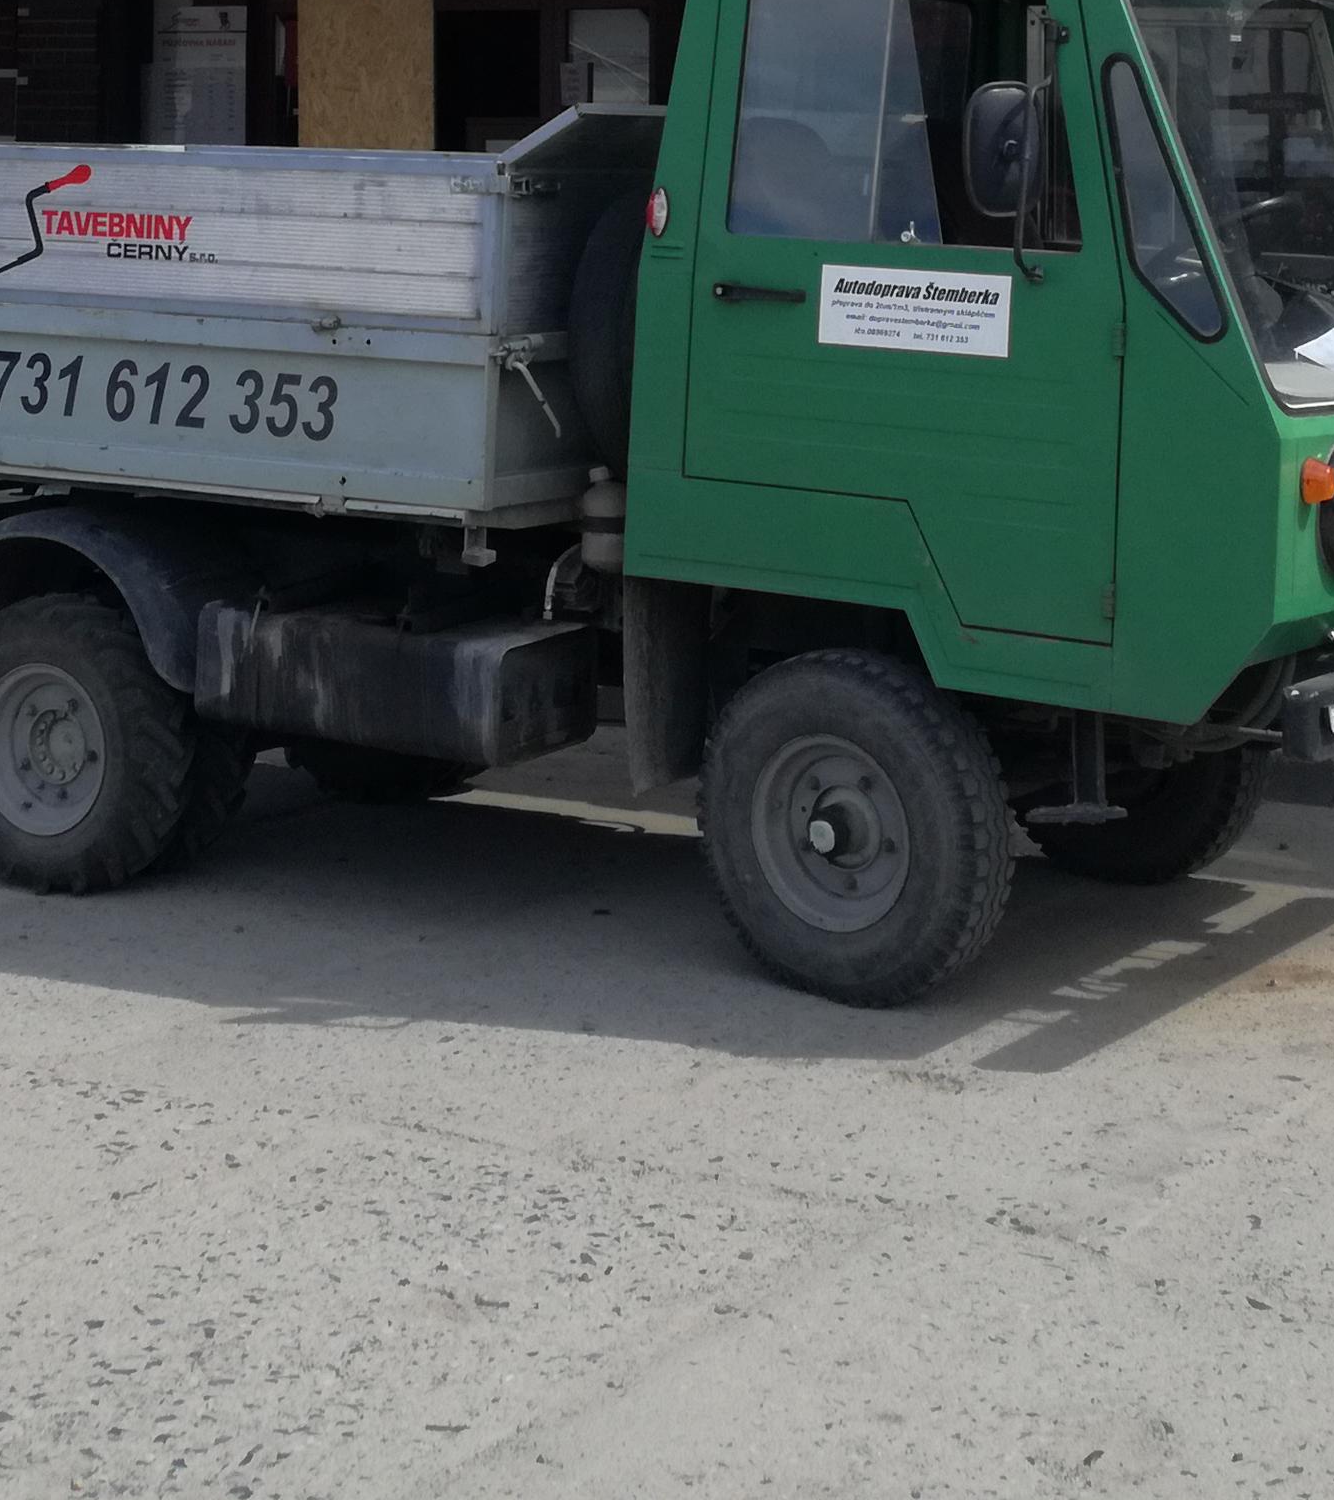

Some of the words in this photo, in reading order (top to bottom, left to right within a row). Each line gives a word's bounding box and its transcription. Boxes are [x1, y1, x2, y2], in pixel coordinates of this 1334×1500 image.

[106, 238, 189, 262] ČERNÝ
[833, 278, 922, 300] Autodoprava
[923, 282, 1000, 306] Štemberka
[105, 358, 211, 429] 612
[228, 369, 338, 442] 353
